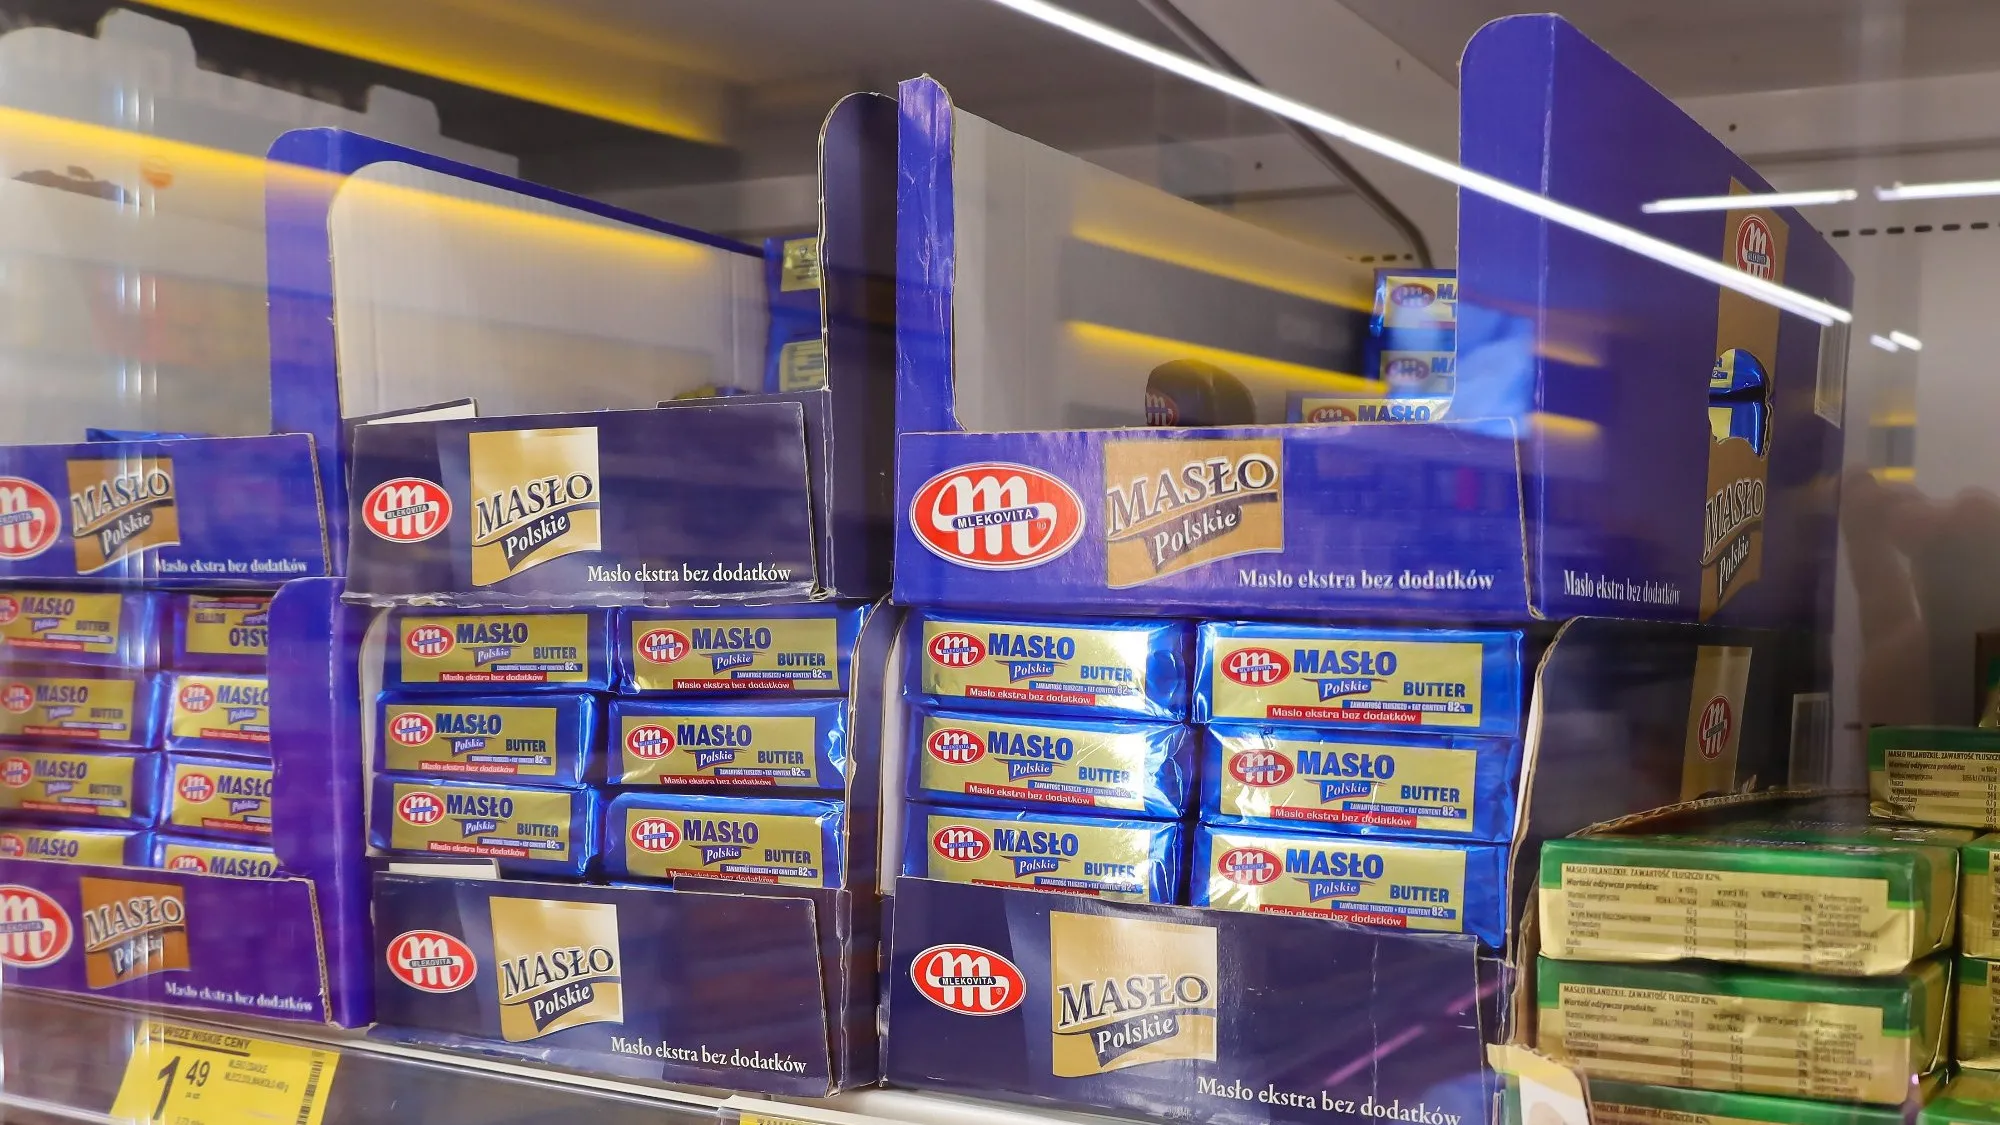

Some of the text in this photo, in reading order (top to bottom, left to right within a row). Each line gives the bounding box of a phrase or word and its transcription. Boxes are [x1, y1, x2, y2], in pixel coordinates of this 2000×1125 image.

[71, 470, 170, 532] MASŁO
[1108, 454, 1279, 538] MASŁO
[386, 504, 428, 519] MLEKOVITA
[475, 472, 594, 541] MASŁO
[957, 510, 1034, 529] MLEKOVITA
[1704, 478, 1765, 555] MASŁO
[102, 512, 150, 554] Polskie
[506, 514, 567, 558] Polskie
[1154, 510, 1236, 566] Polskie
[588, 562, 791, 583] Masło ekstra bez dodatków
[1719, 535, 1749, 598] Polskie
[1238, 569, 1494, 591] Masło ekstra bez dodatków
[1564, 570, 1680, 605] Masło ekstra bez dodatków
[22, 597, 74, 616] MASŁO
[456, 622, 528, 644] MASŁO
[692, 627, 771, 650] MASŁO
[478, 648, 509, 663] Polskie
[533, 646, 577, 660] BUTTER
[988, 633, 1075, 660] MASŁO
[716, 654, 750, 668] Polskie
[778, 652, 825, 666] BUTTER
[1293, 649, 1397, 676] MASŁO
[1014, 662, 1051, 678] Polskie
[1080, 665, 1133, 681] BUTTER
[36, 685, 88, 704] MASŁO
[970, 688, 1091, 704] Masło ekstra bez dodatków
[1323, 681, 1368, 698] Polskie
[1403, 681, 1465, 698] BUTTER
[435, 713, 502, 735] MASŁO
[1272, 707, 1416, 722] Masło ekstra bez dodatków
[455, 738, 484, 752] Polskie
[506, 739, 546, 752] BUTTER
[677, 724, 752, 748] MASŁO
[987, 731, 1074, 761] MASŁO
[700, 751, 733, 767] Polskie
[758, 750, 804, 764] BUTTER
[1297, 750, 1394, 780] MASŁO
[35, 760, 87, 779] MASŁO
[1013, 761, 1050, 776] Polskie
[1078, 766, 1129, 782] BUTTER
[217, 776, 272, 797] MASŁO
[969, 785, 1090, 805] Masło ekstra bez dodatków
[1325, 781, 1368, 798] Polskie
[1400, 785, 1460, 803] BUTTER
[447, 794, 513, 818] MASŁO
[1275, 808, 1412, 826] Masło ekstra bez dodatków
[465, 821, 495, 835] Polskie
[517, 823, 559, 838] BUTTER
[683, 819, 759, 844] MASŁO
[28, 838, 78, 857] MASŁO
[994, 828, 1079, 856] MASŁO
[707, 847, 739, 863] Polskie
[764, 849, 811, 864] BUTTER
[1285, 849, 1384, 879] MASŁO
[210, 856, 271, 878] MASŁO
[1019, 857, 1056, 873] Polskie
[1314, 881, 1357, 897] Polskie
[1390, 884, 1449, 903] BUTTER
[84, 896, 185, 948] MASŁO
[1351, 912, 1402, 926] dodatków
[410, 957, 453, 968] MLEKOVITA
[501, 946, 615, 1000] MASŁO
[942, 975, 995, 987] MLEKOVITA
[534, 984, 591, 1020] Polskie
[1058, 975, 1211, 1031] MASŁO
[224, 1037, 252, 1049] CENY
[1098, 1015, 1174, 1055] Polskie
[611, 1036, 807, 1074] Masło ekstra bez dodatków
[153, 1056, 180, 1120] 1
[185, 1059, 211, 1088] 49
[1198, 1076, 1461, 1125] Masło ekstra bez dodatków
